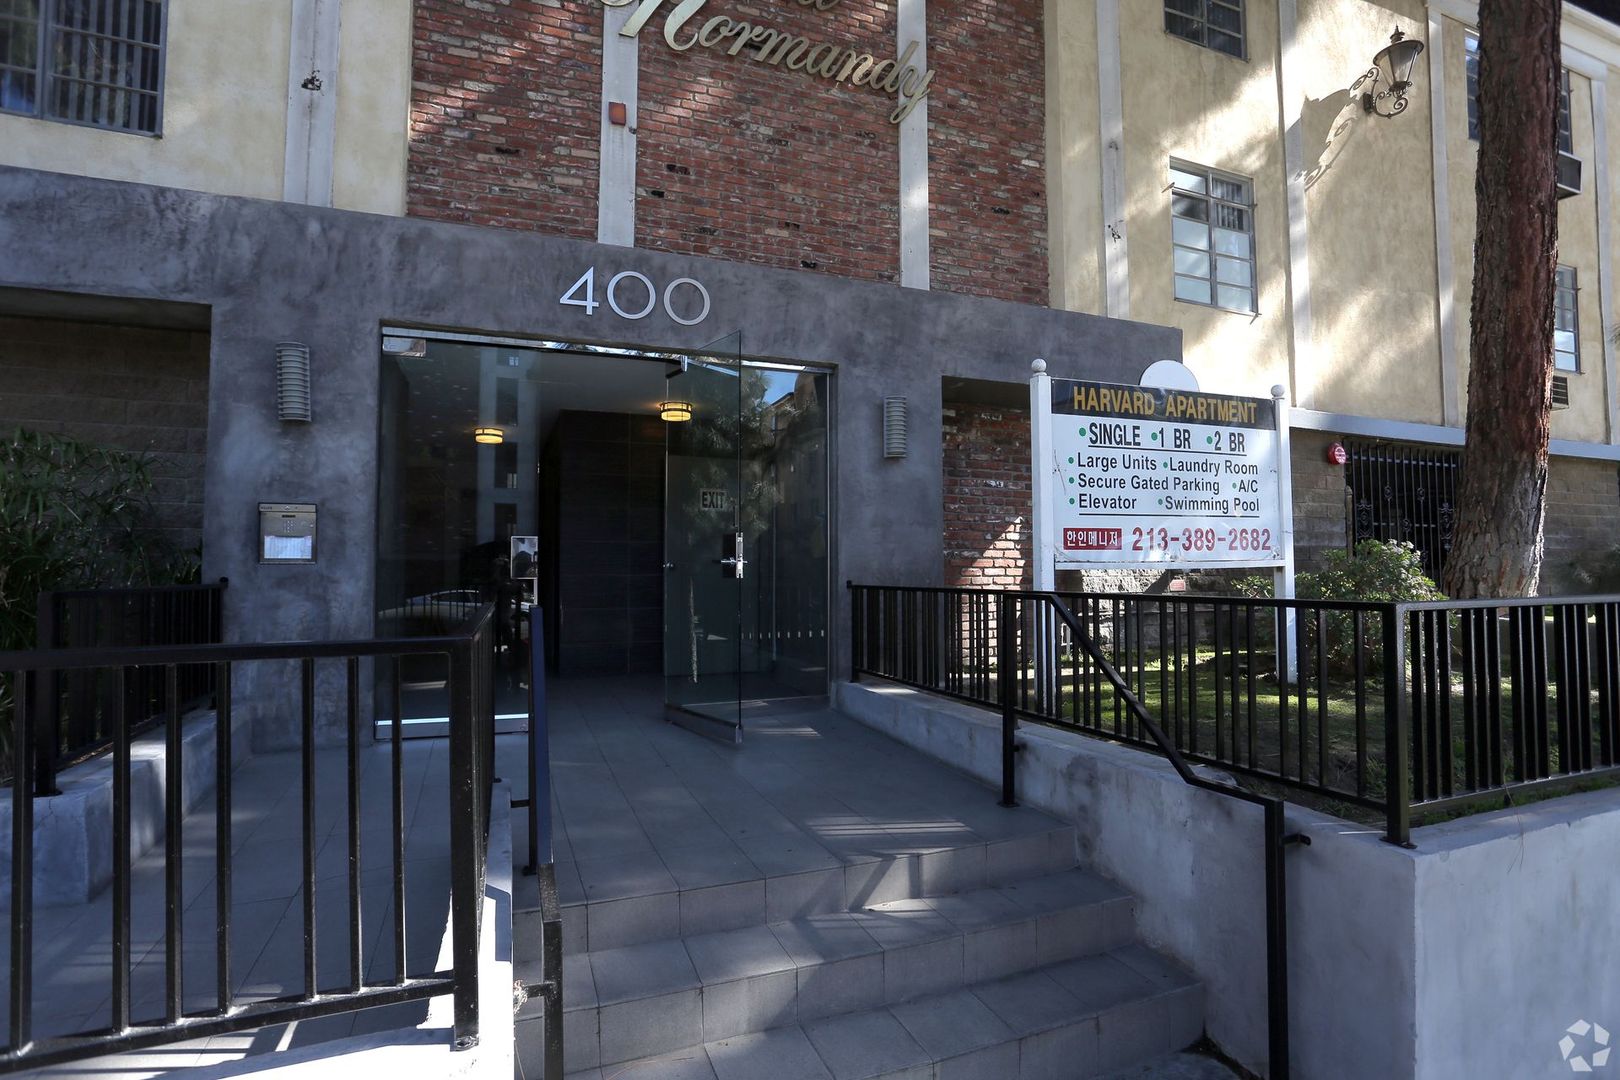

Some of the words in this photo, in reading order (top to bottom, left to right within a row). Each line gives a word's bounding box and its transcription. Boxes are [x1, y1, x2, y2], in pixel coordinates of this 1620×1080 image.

[559, 266, 711, 326] 400
[1073, 386, 1155, 416] HARVARD
[1165, 394, 1257, 424] APARTMENT
[1089, 422, 1141, 447] SINGLE
[1158, 427, 1164, 448] 1
[1174, 428, 1191, 450] BR
[1214, 430, 1222, 451] 2
[1229, 432, 1245, 453] BR
[1077, 452, 1118, 473] Large
[1122, 454, 1157, 471] Units
[1169, 457, 1221, 477] Laundry
[1224, 460, 1258, 475] Room
[1078, 473, 1126, 490] Secure
[1131, 475, 1169, 491] Gated
[1173, 477, 1220, 495] Parking
[1238, 479, 1259, 494] A/C
[702, 491, 727, 509] EXIT
[1079, 493, 1137, 510] Elevator
[1165, 495, 1229, 515] Swimming
[1233, 497, 1260, 512] Pool
[1066, 530, 1118, 547] 한인메니저
[1132, 526, 1271, 552] 213-389-2682
